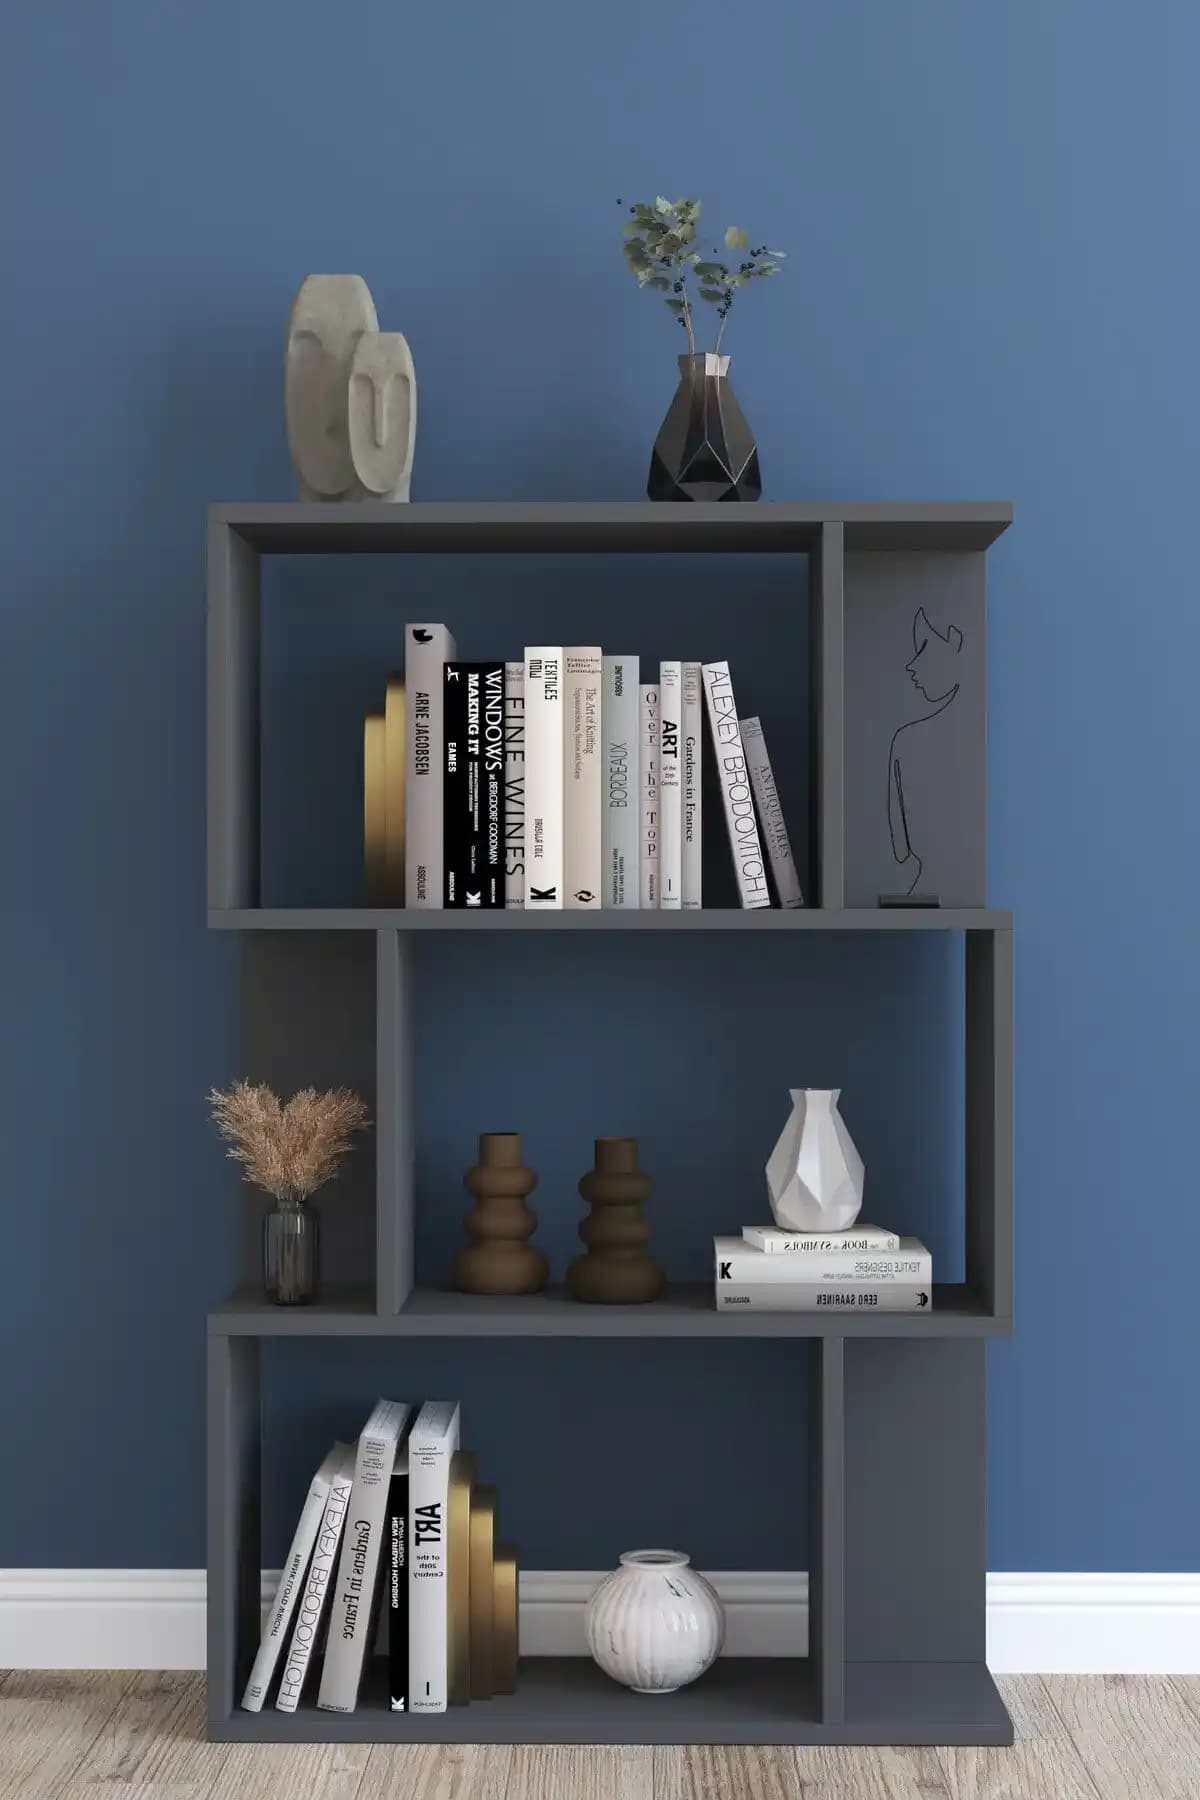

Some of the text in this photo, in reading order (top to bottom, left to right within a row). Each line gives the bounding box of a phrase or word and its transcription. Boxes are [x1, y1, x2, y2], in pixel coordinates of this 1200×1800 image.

[530, 660, 542, 678] NOW
[545, 660, 557, 700] TEXTILES
[468, 673, 479, 755] MAKING IT
[586, 688, 596, 701] The
[586, 703, 596, 714] Art
[416, 692, 429, 775] ARNE JACOBSEN
[485, 669, 502, 770] WINDOWS
[505, 698, 524, 762] FINE
[647, 693, 657, 745] Over
[663, 720, 677, 758] ART
[448, 742, 457, 772] EAMES
[584, 725, 596, 754] Knitting
[610, 742, 627, 807] BORDEAUX
[648, 762, 657, 798] the
[686, 737, 695, 842] Gardens in France
[708, 670, 740, 748] ALEXEY
[724, 757, 765, 892] BRODOVITCH
[489, 781, 498, 821] BERGDORF
[759, 765, 790, 859] ANTIQUAIRES
[489, 823, 498, 864] GOODMAN
[505, 777, 524, 876] WINES
[535, 845, 543, 858] COLE
[417, 865, 426, 900] ASSOULINE
[721, 1262, 732, 1279] K
